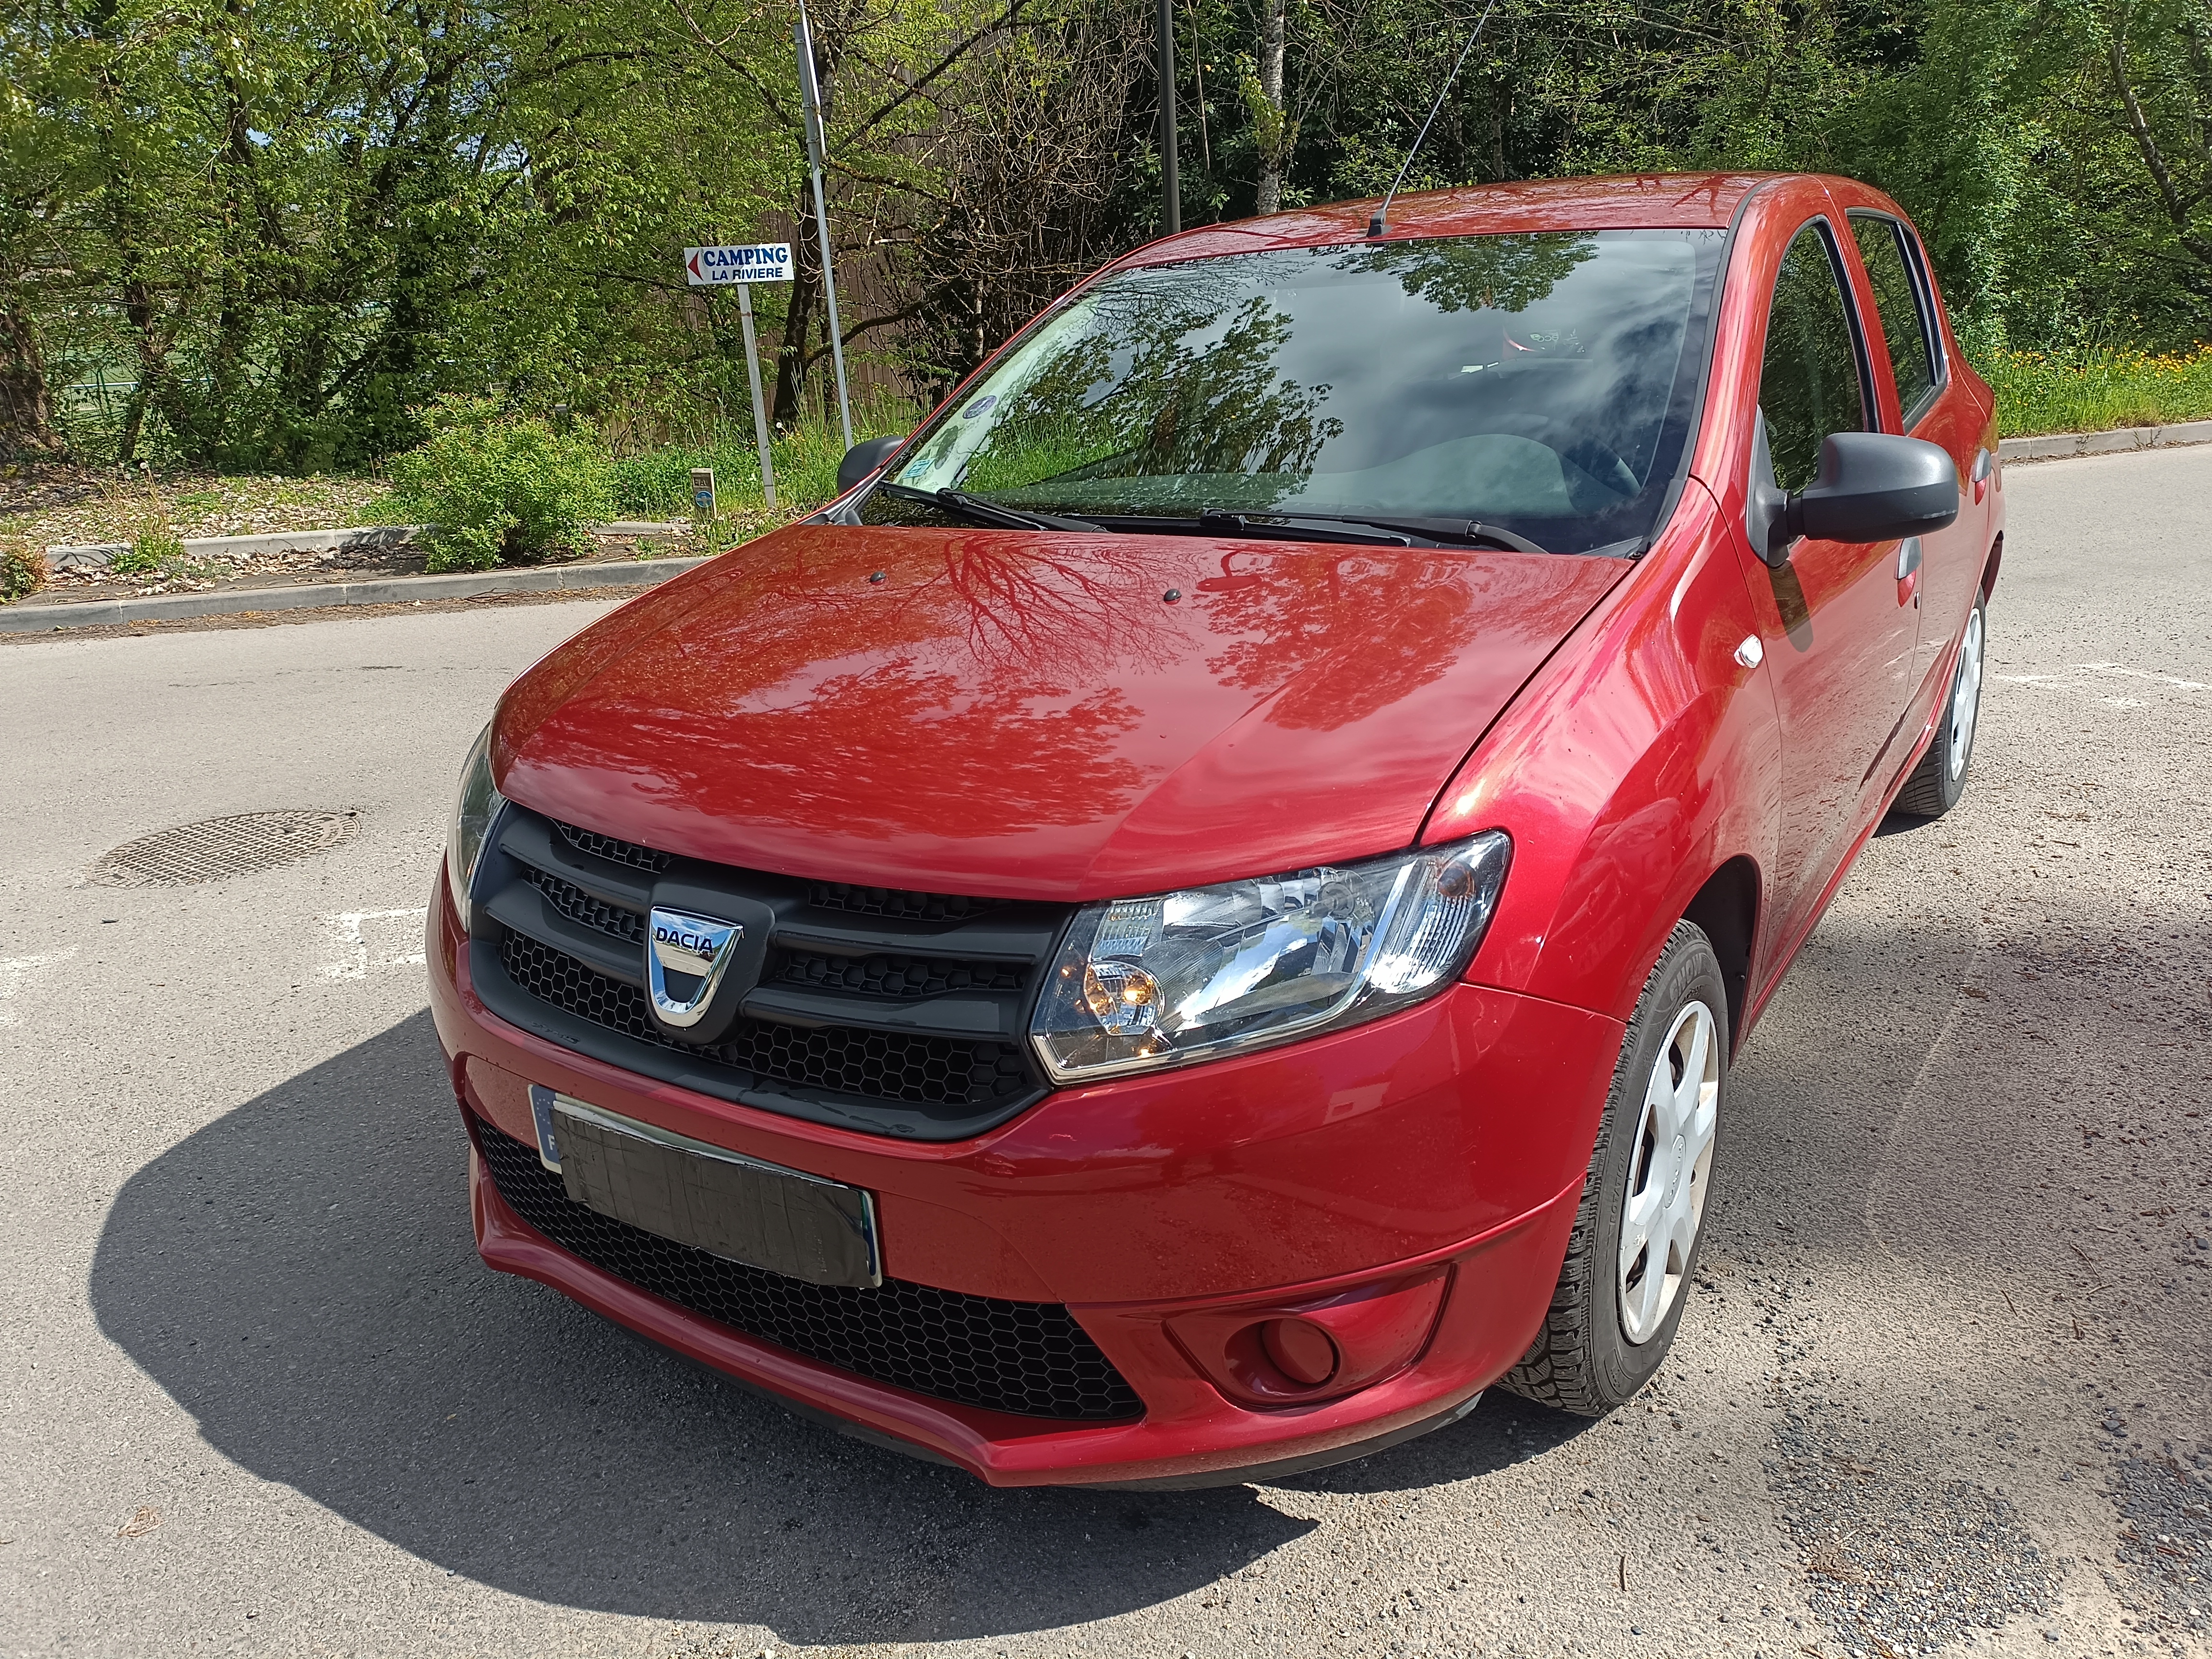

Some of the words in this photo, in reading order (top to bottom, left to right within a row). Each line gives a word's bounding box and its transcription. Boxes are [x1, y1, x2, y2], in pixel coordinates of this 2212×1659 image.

[704, 247, 788, 266] CAMPING
[712, 270, 728, 280] LA
[733, 267, 782, 279] RIVIERE
[656, 926, 713, 954] DACIA
[548, 1134, 555, 1151] F
